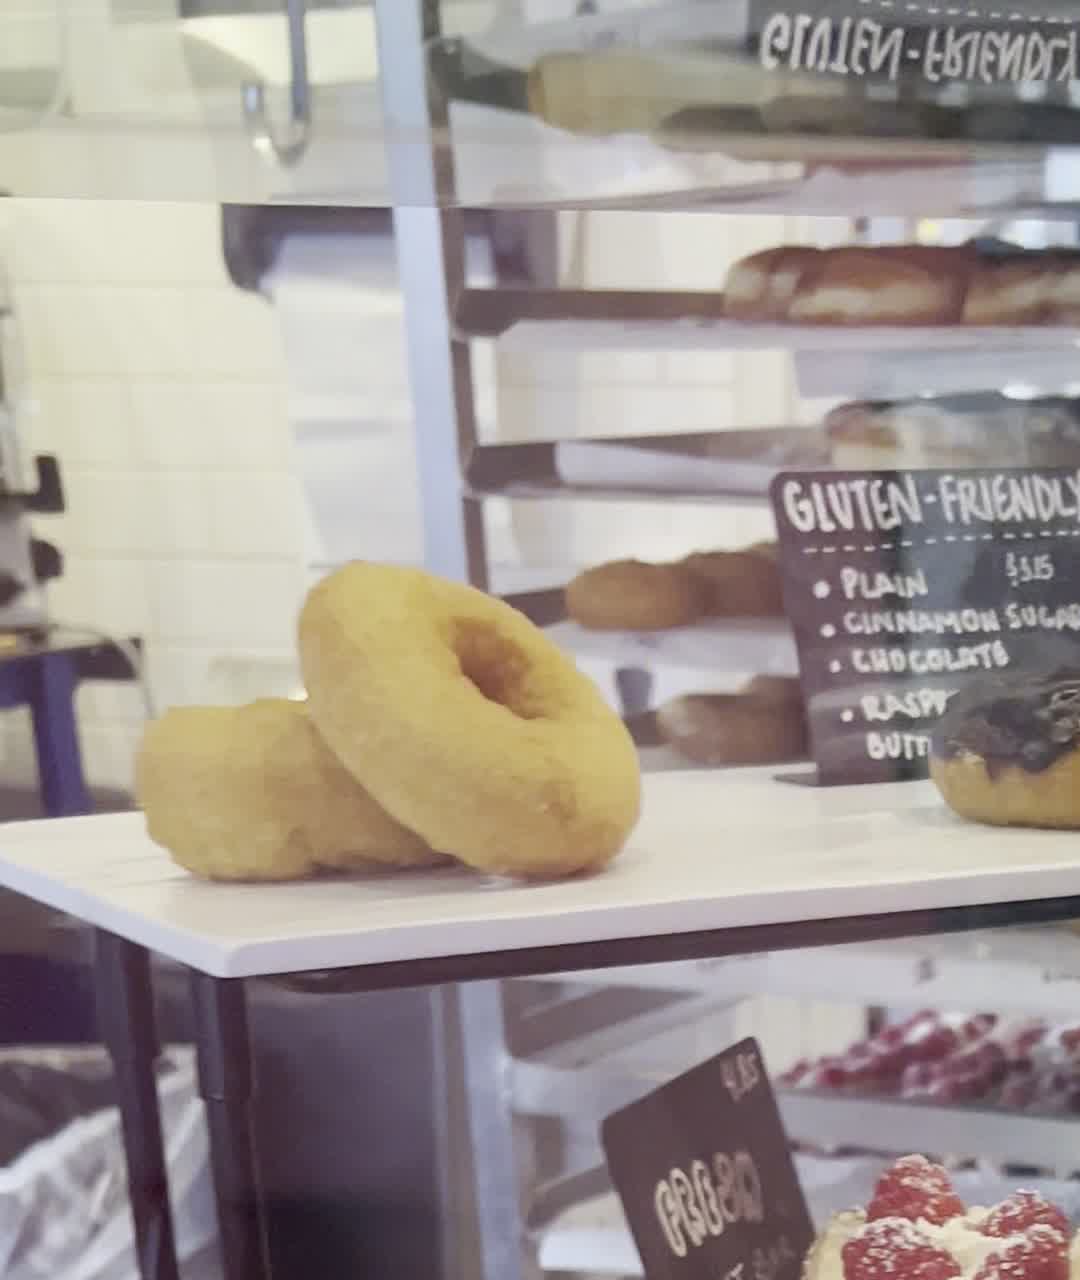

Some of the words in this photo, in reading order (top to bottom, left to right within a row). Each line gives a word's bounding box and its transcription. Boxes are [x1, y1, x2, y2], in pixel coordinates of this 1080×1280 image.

[839, 567, 929, 600] PLAIN
[843, 609, 1000, 635] CINNAMON
[852, 640, 1009, 673] CHOCOLATE
